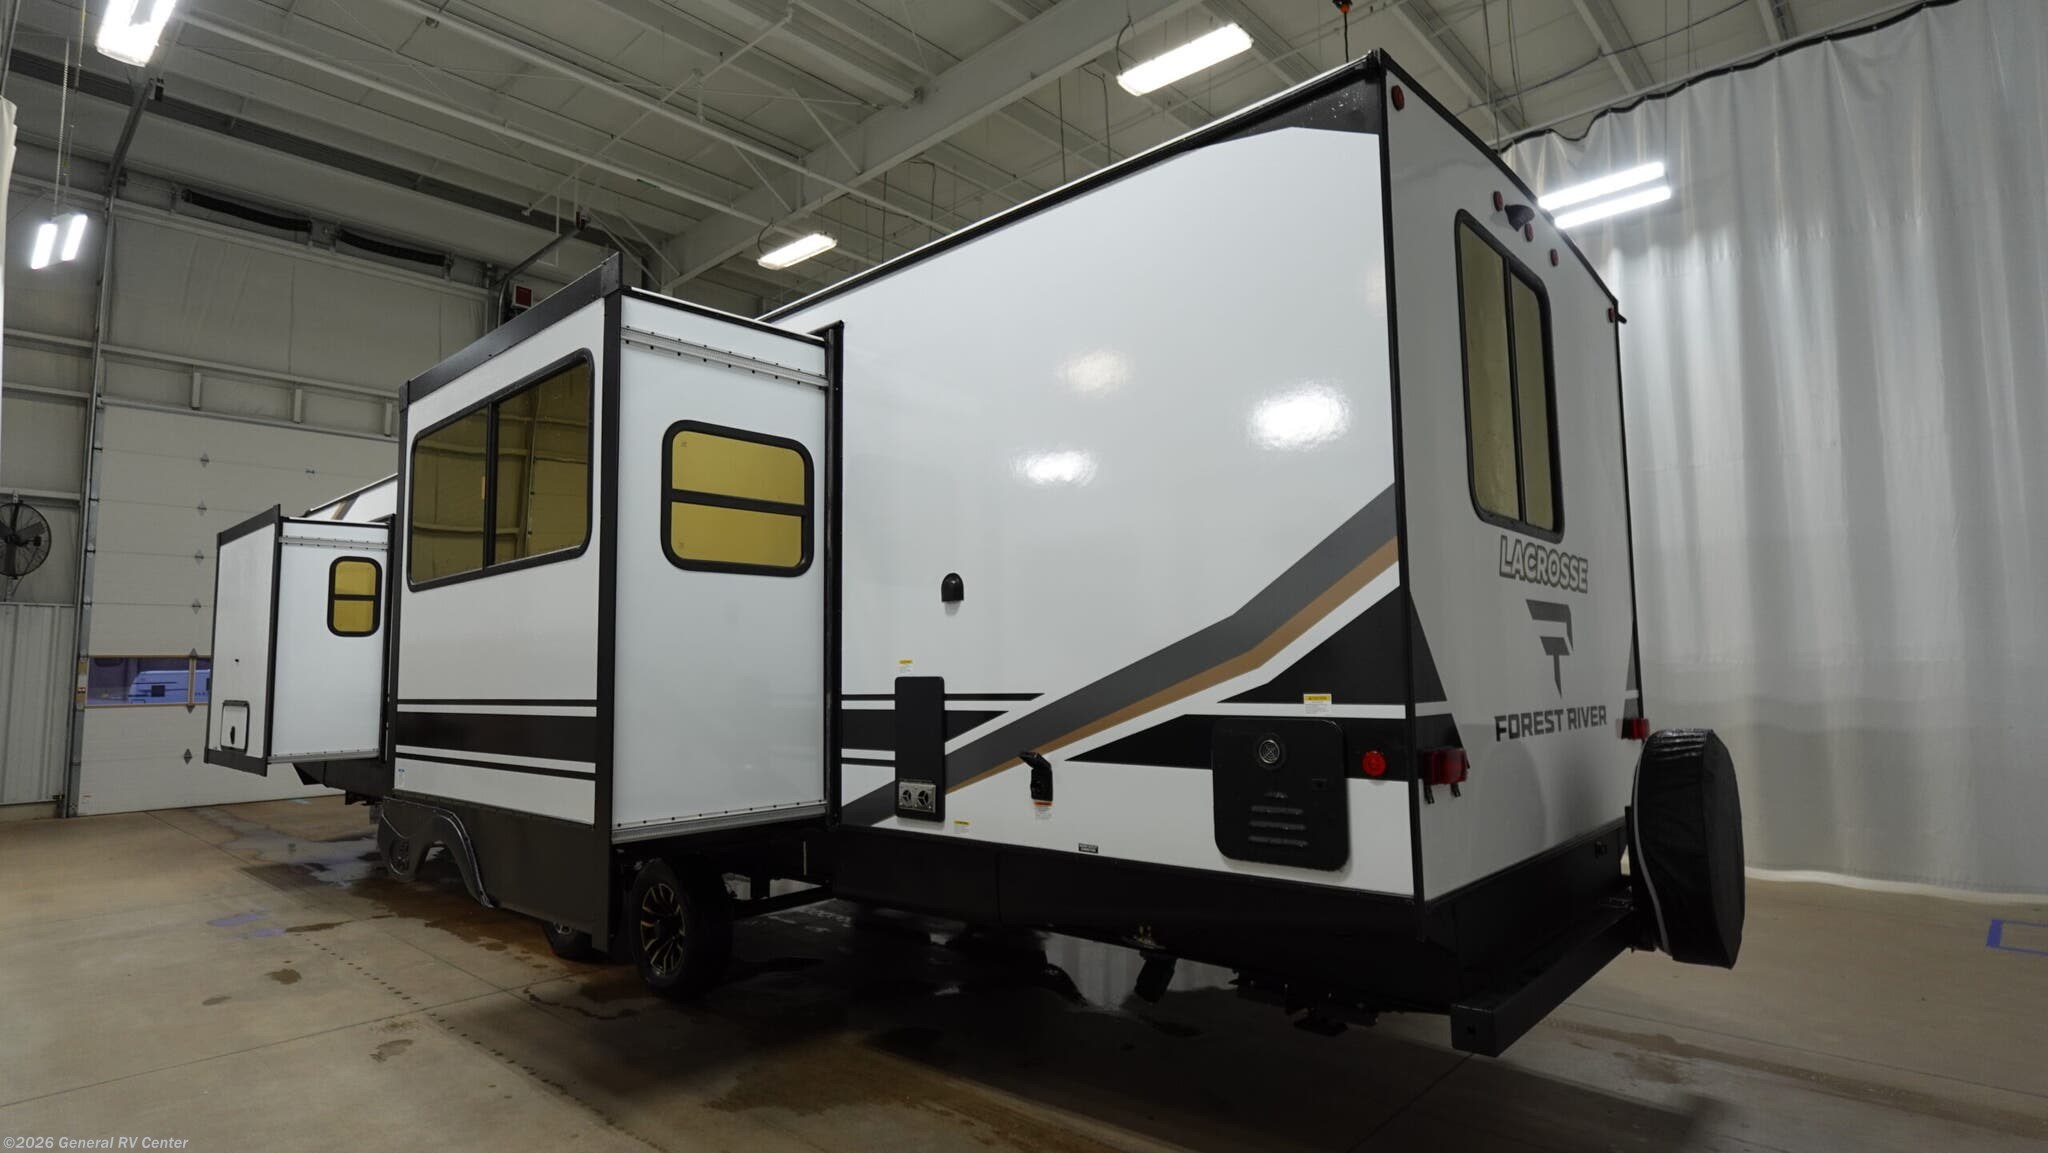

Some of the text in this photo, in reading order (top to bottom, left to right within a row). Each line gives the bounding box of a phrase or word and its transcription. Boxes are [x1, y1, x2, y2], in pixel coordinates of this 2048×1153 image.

[1500, 536, 1588, 593] LACROSSE
[1494, 705, 1607, 742] FOREST RIVER
